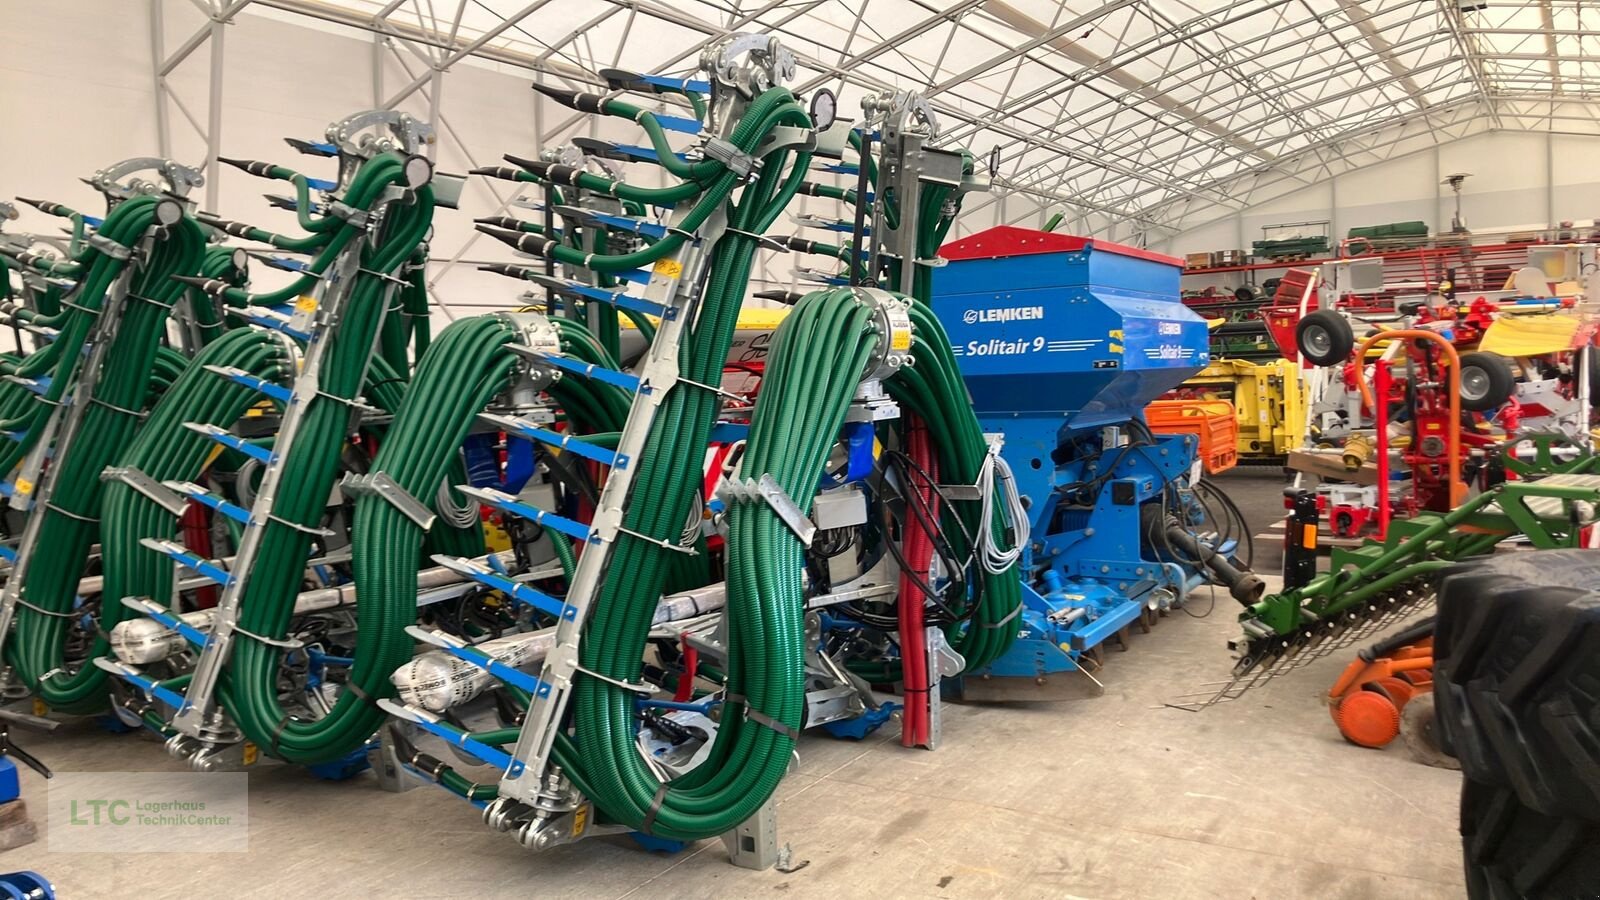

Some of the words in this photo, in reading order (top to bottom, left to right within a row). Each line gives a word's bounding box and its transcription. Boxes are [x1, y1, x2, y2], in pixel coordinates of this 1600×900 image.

[979, 306, 1043, 323] LEMKEN
[966, 338, 1030, 356] Solitair
[1032, 336, 1045, 352] 9
